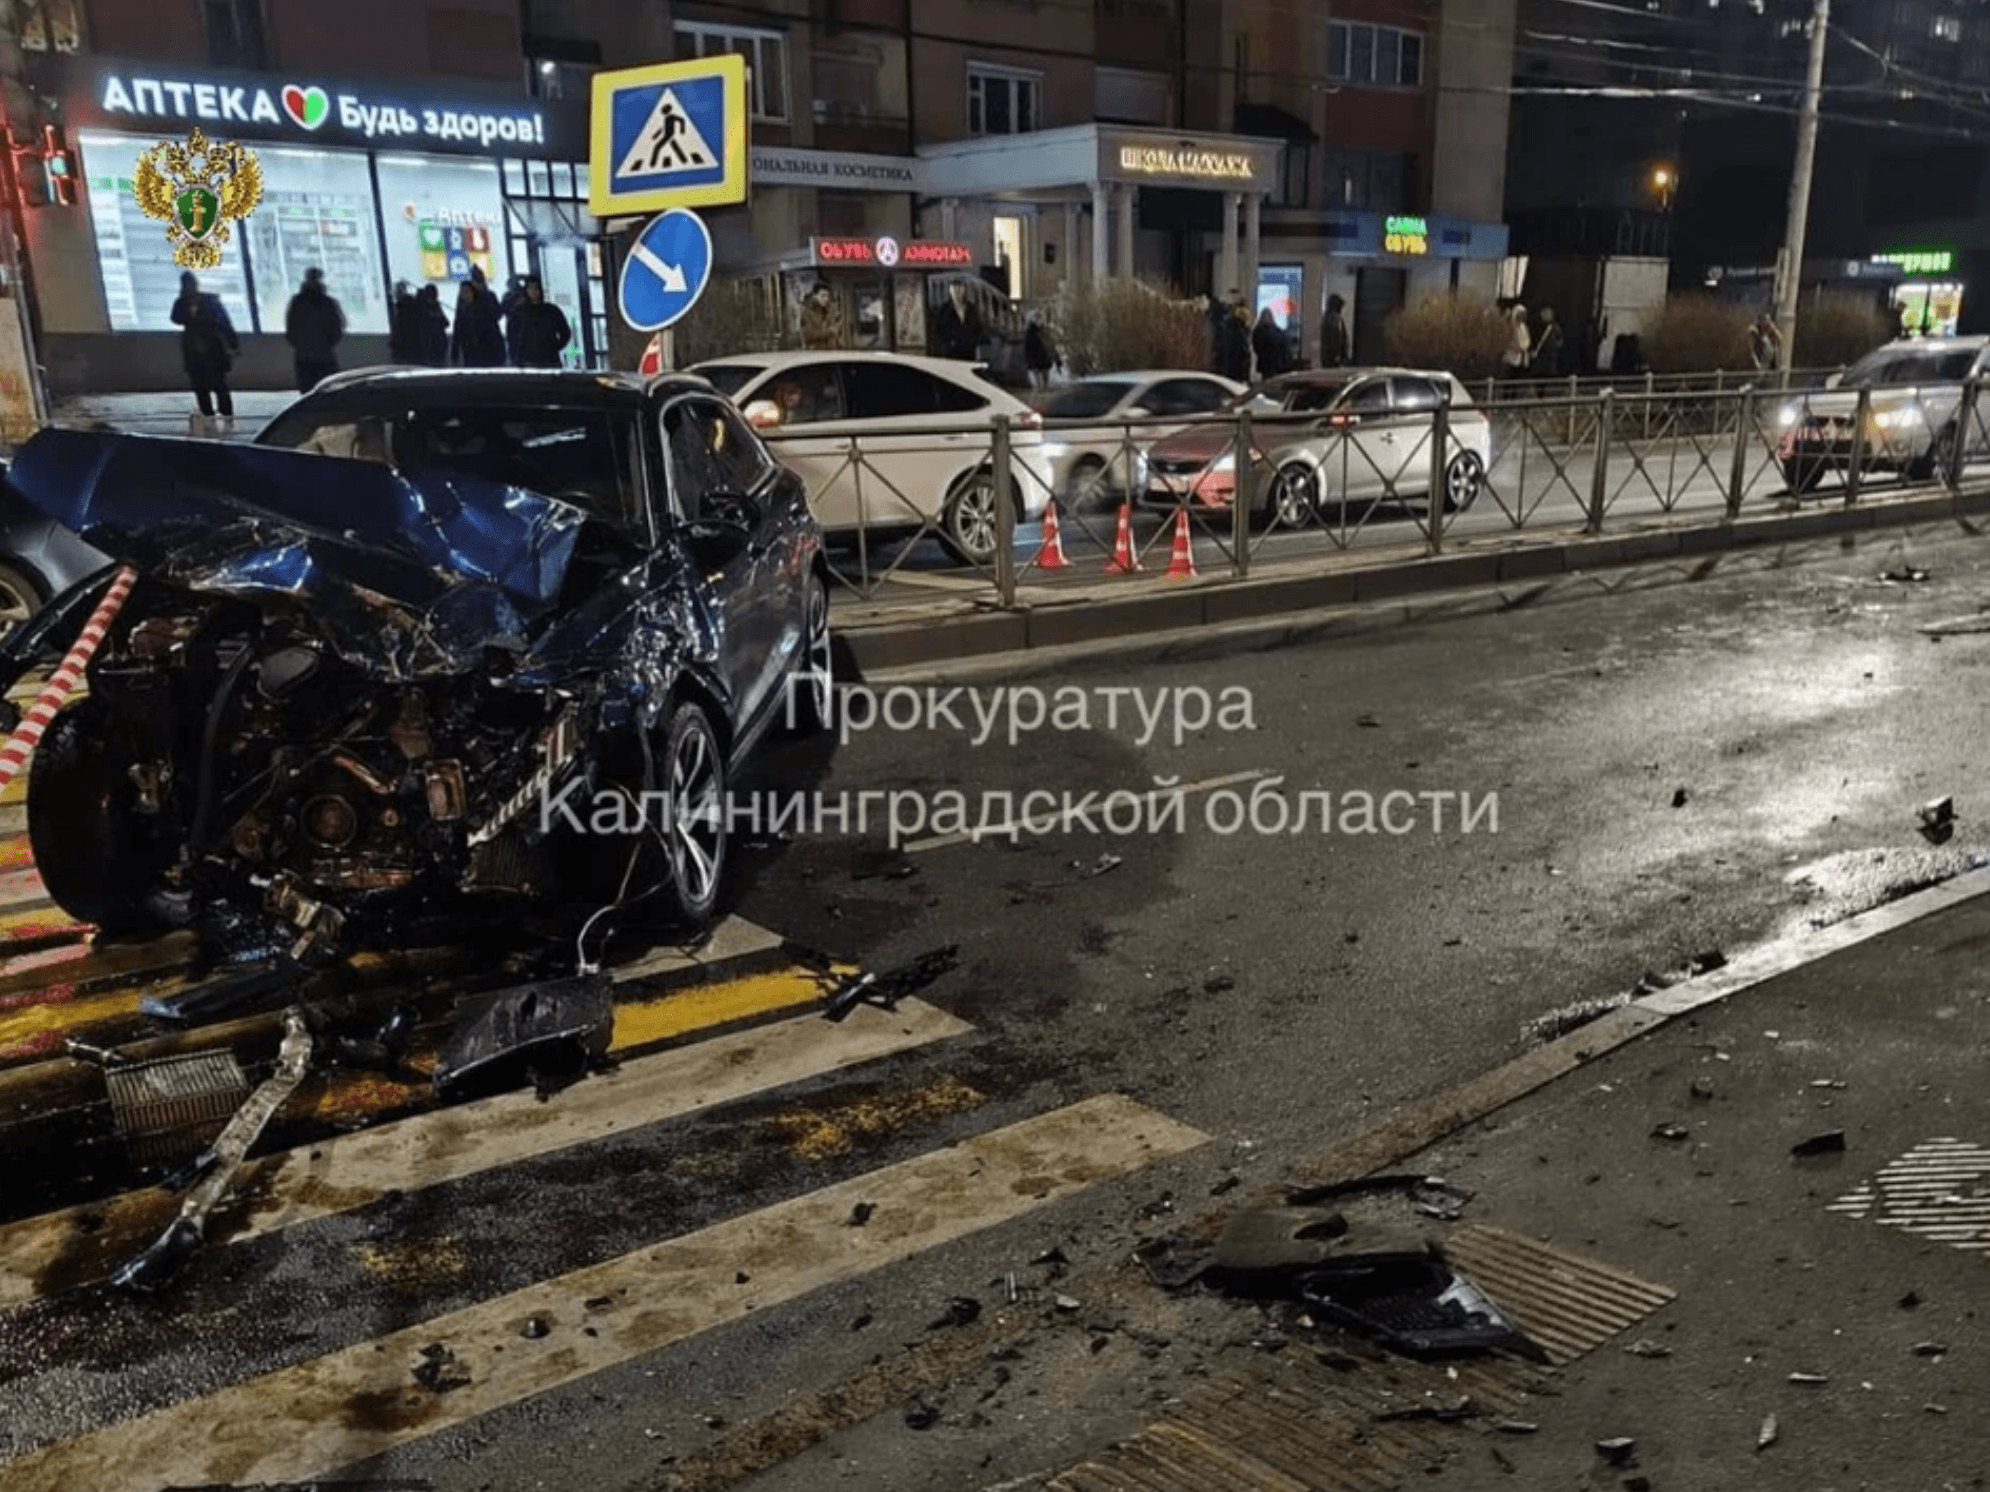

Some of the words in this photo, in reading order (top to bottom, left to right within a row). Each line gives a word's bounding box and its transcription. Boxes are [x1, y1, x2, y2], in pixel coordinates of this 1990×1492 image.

[103, 76, 281, 124] АПТЕКА
[338, 95, 418, 138] Будь
[422, 110, 544, 147] здоров!
[834, 163, 913, 181] КОСМЕТИКА
